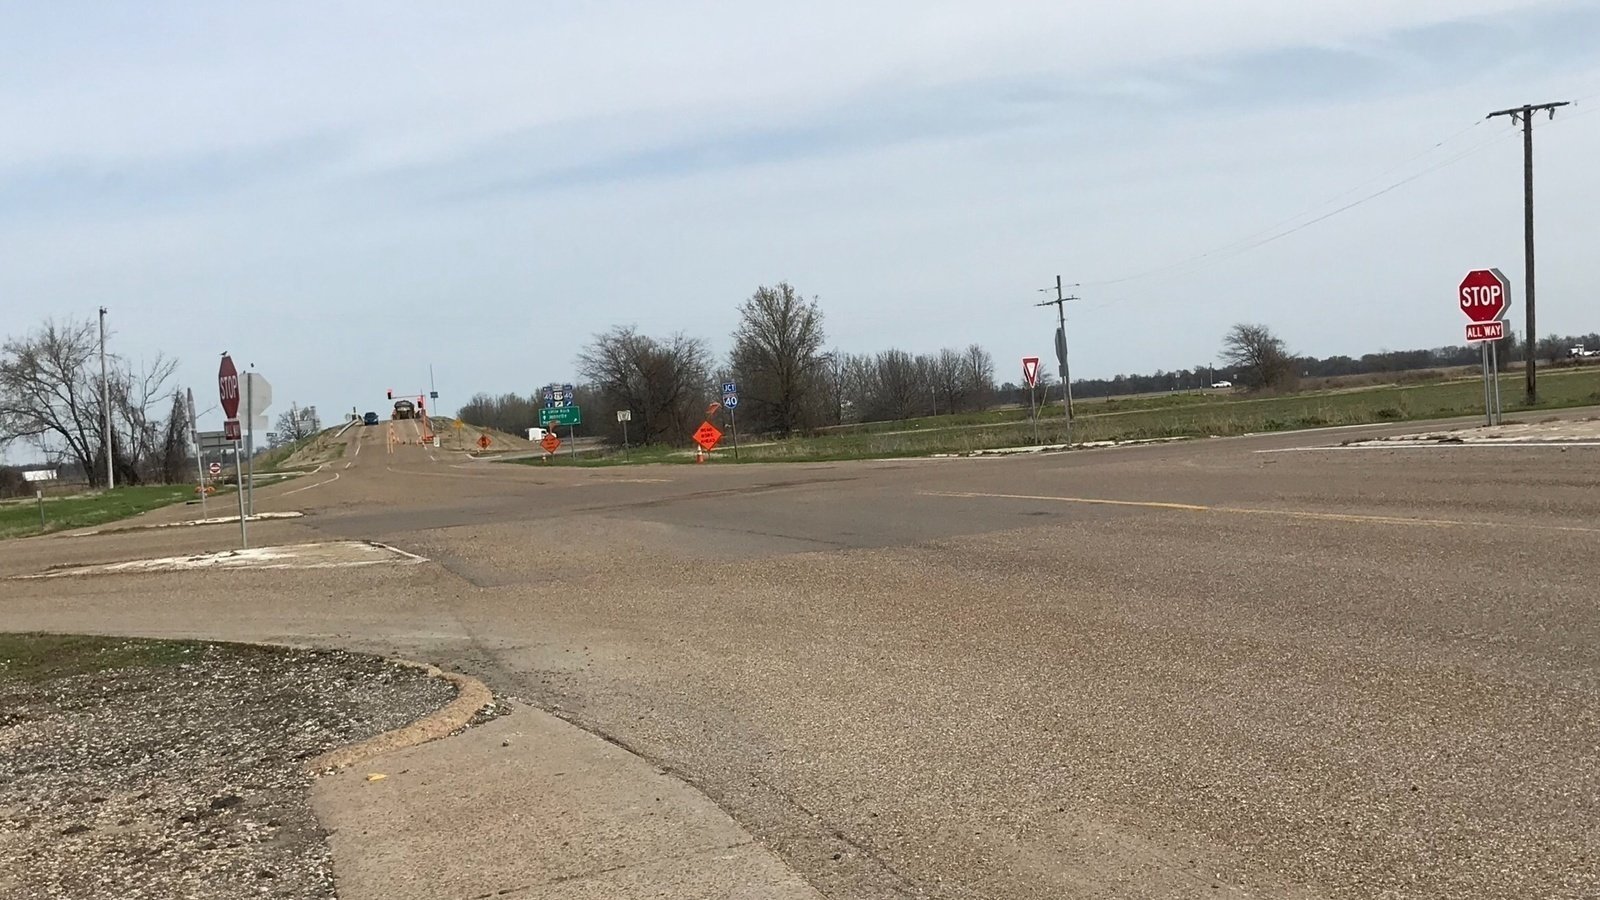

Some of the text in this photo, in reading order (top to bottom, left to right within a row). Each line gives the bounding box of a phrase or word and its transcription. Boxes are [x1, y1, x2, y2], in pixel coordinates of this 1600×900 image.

[1462, 285, 1501, 307] STOP
[1467, 325, 1501, 338] ALL WAY
[220, 375, 237, 400] STOP
[725, 396, 738, 406] 40
